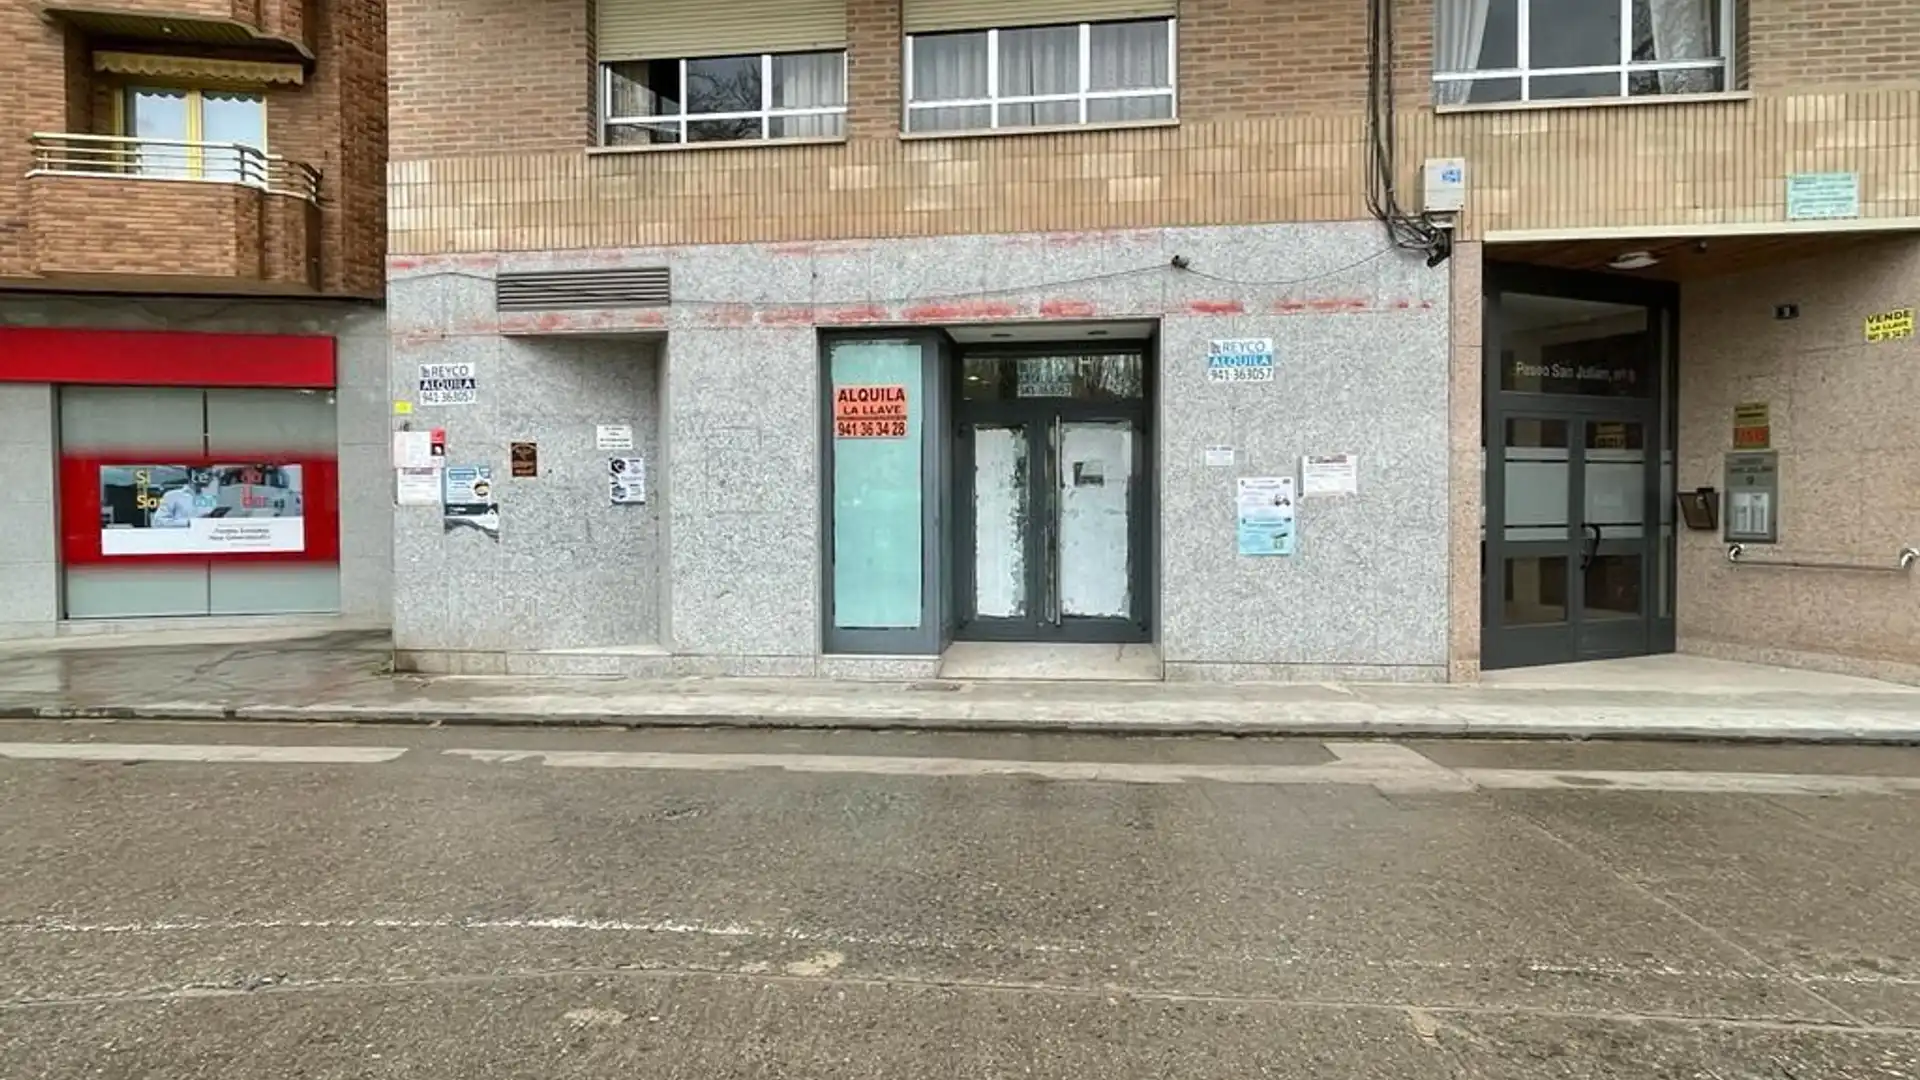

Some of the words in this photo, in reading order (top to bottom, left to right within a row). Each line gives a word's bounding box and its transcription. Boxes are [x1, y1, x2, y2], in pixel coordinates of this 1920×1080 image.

[1867, 309, 1911, 324] VENDE
[1223, 341, 1265, 353] REYCO
[1211, 354, 1270, 367] ALQUILA
[431, 365, 469, 378] REYCO
[1211, 369, 1229, 380] 941
[1233, 367, 1272, 380] 363057
[422, 378, 472, 391] ALQUILA
[422, 391, 438, 403] 941
[838, 387, 905, 402] ALQUILA
[844, 405, 858, 415] LA
[862, 404, 902, 414] LLAVE
[838, 421, 857, 436] 941
[860, 421, 874, 436] 36
[876, 421, 889, 436] 34
[892, 421, 905, 436] 28
